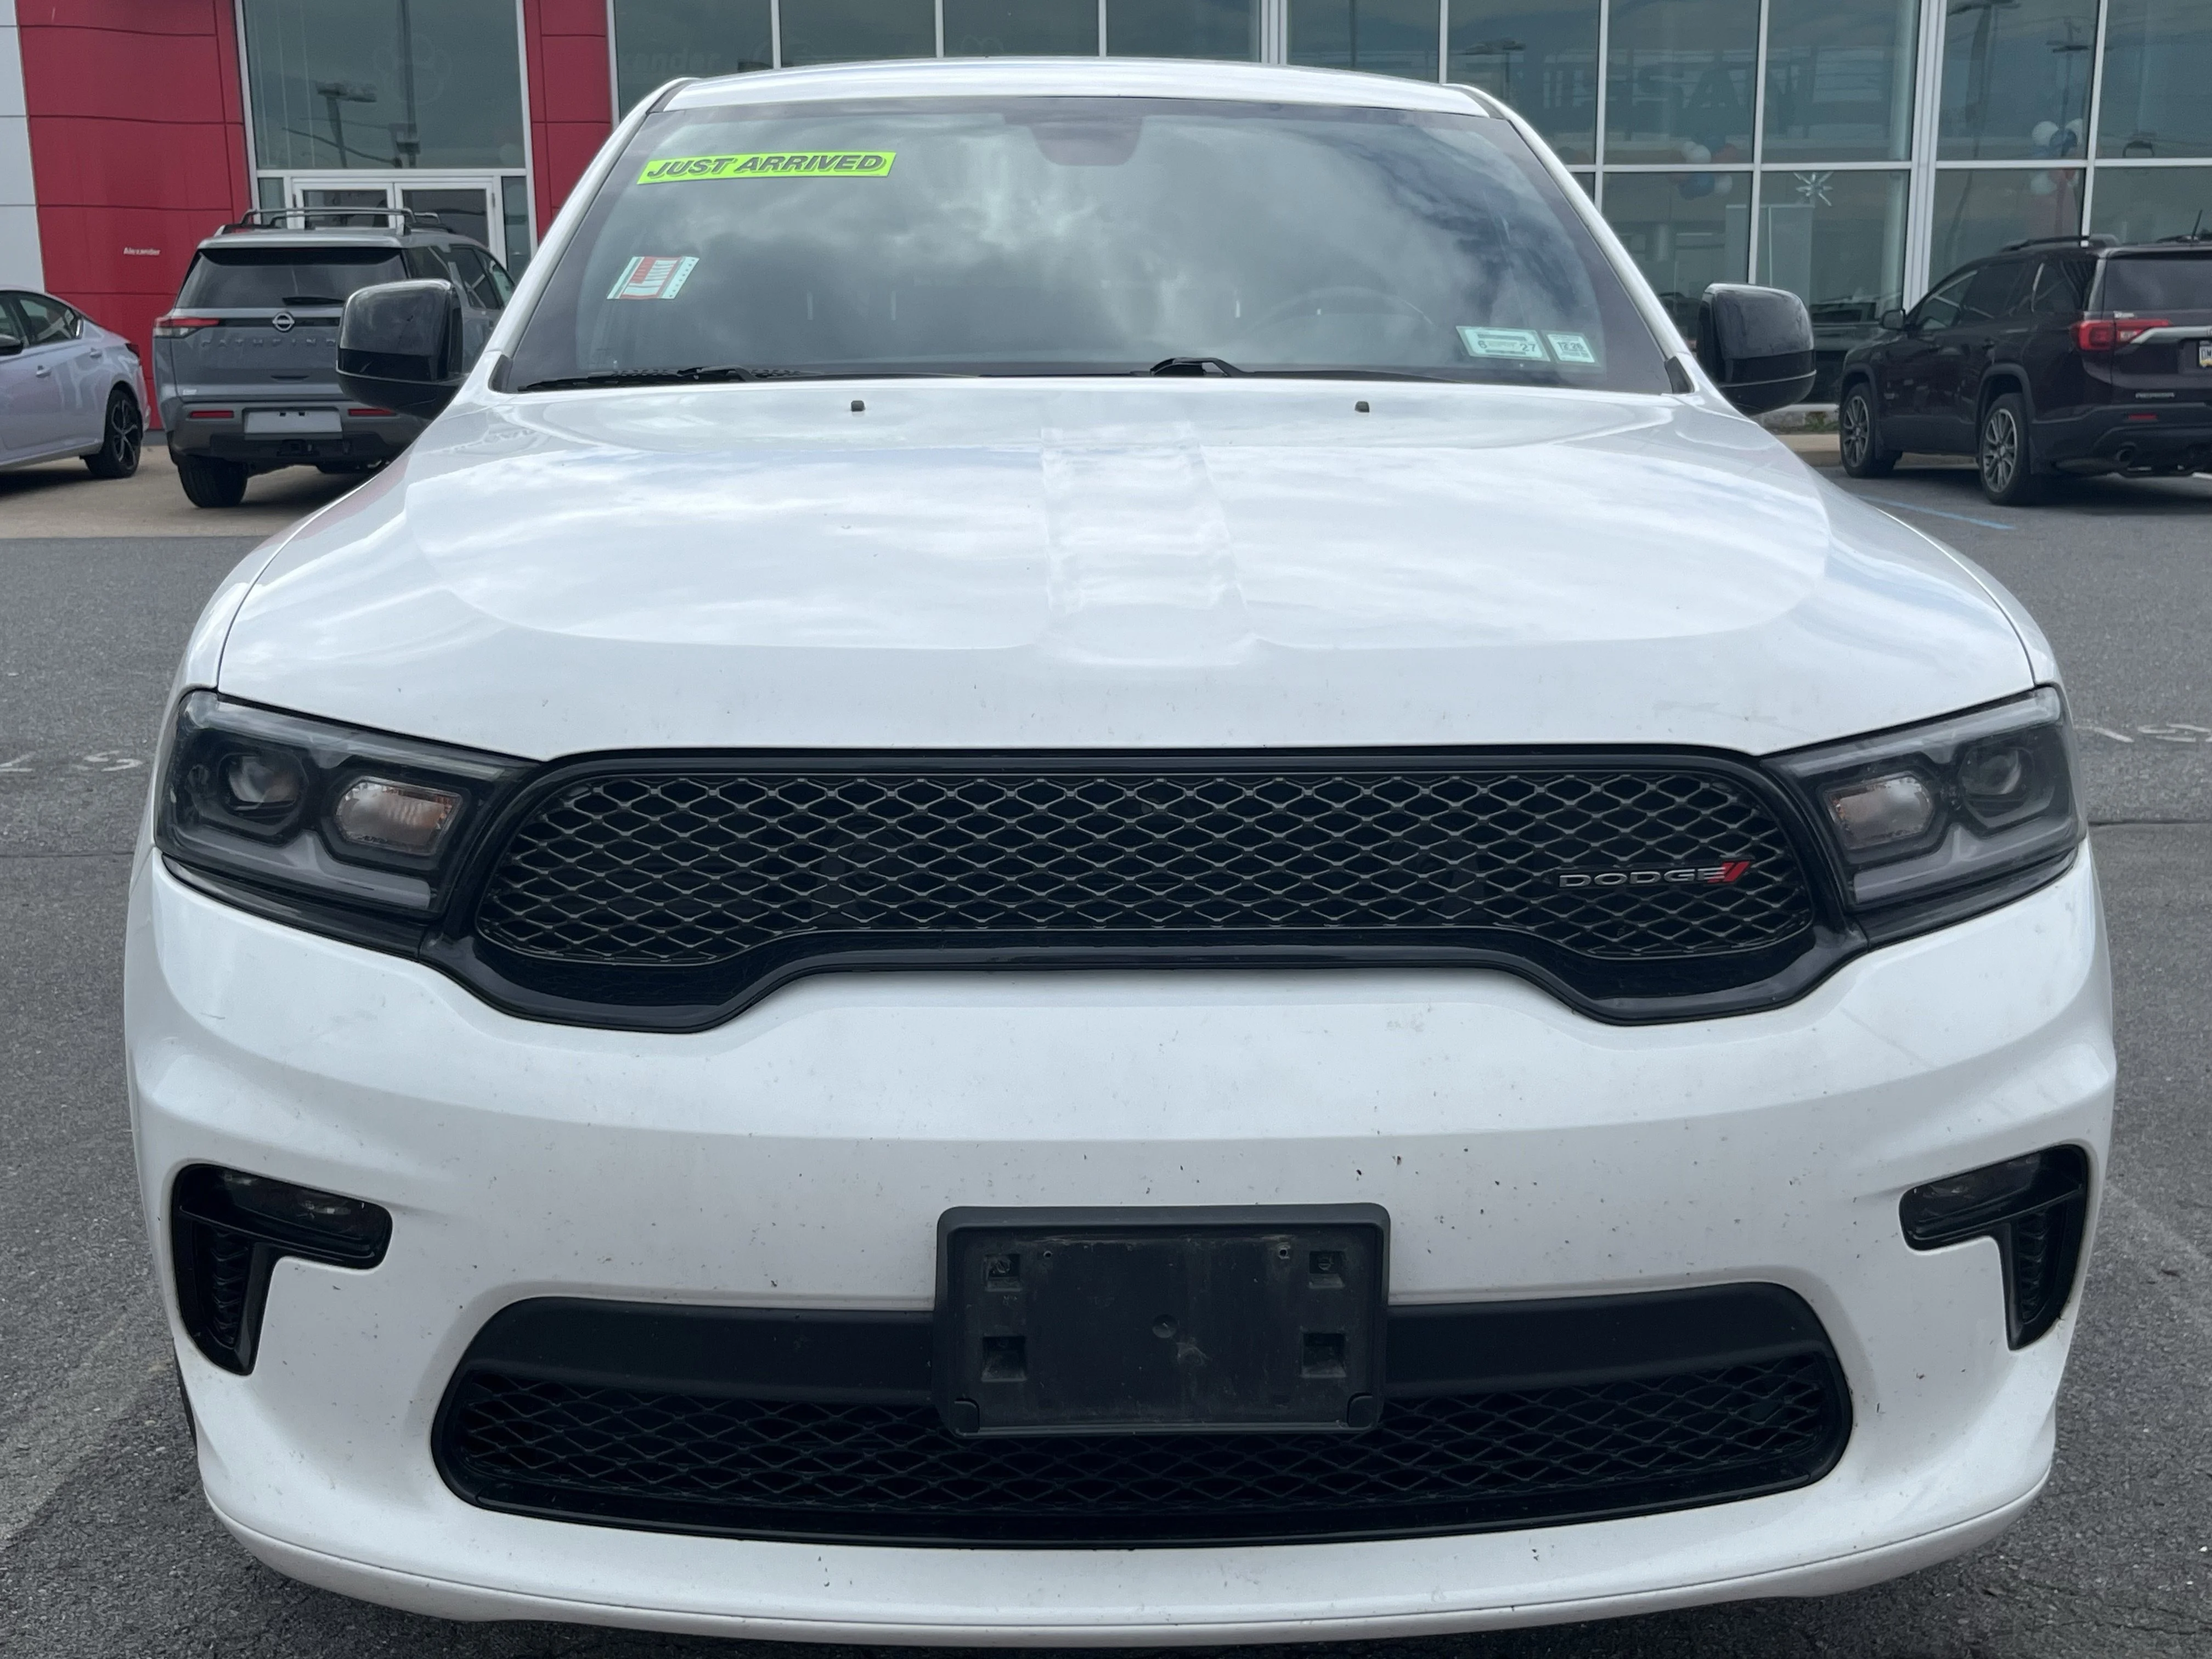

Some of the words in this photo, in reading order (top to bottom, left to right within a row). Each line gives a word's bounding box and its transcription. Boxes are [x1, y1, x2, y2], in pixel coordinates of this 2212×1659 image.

[647, 157, 737, 179] JUST
[735, 154, 887, 173] ARRIVED
[1477, 340, 1487, 349] 6
[1520, 343, 1536, 352] 27
[1559, 866, 1726, 888] DODGE
